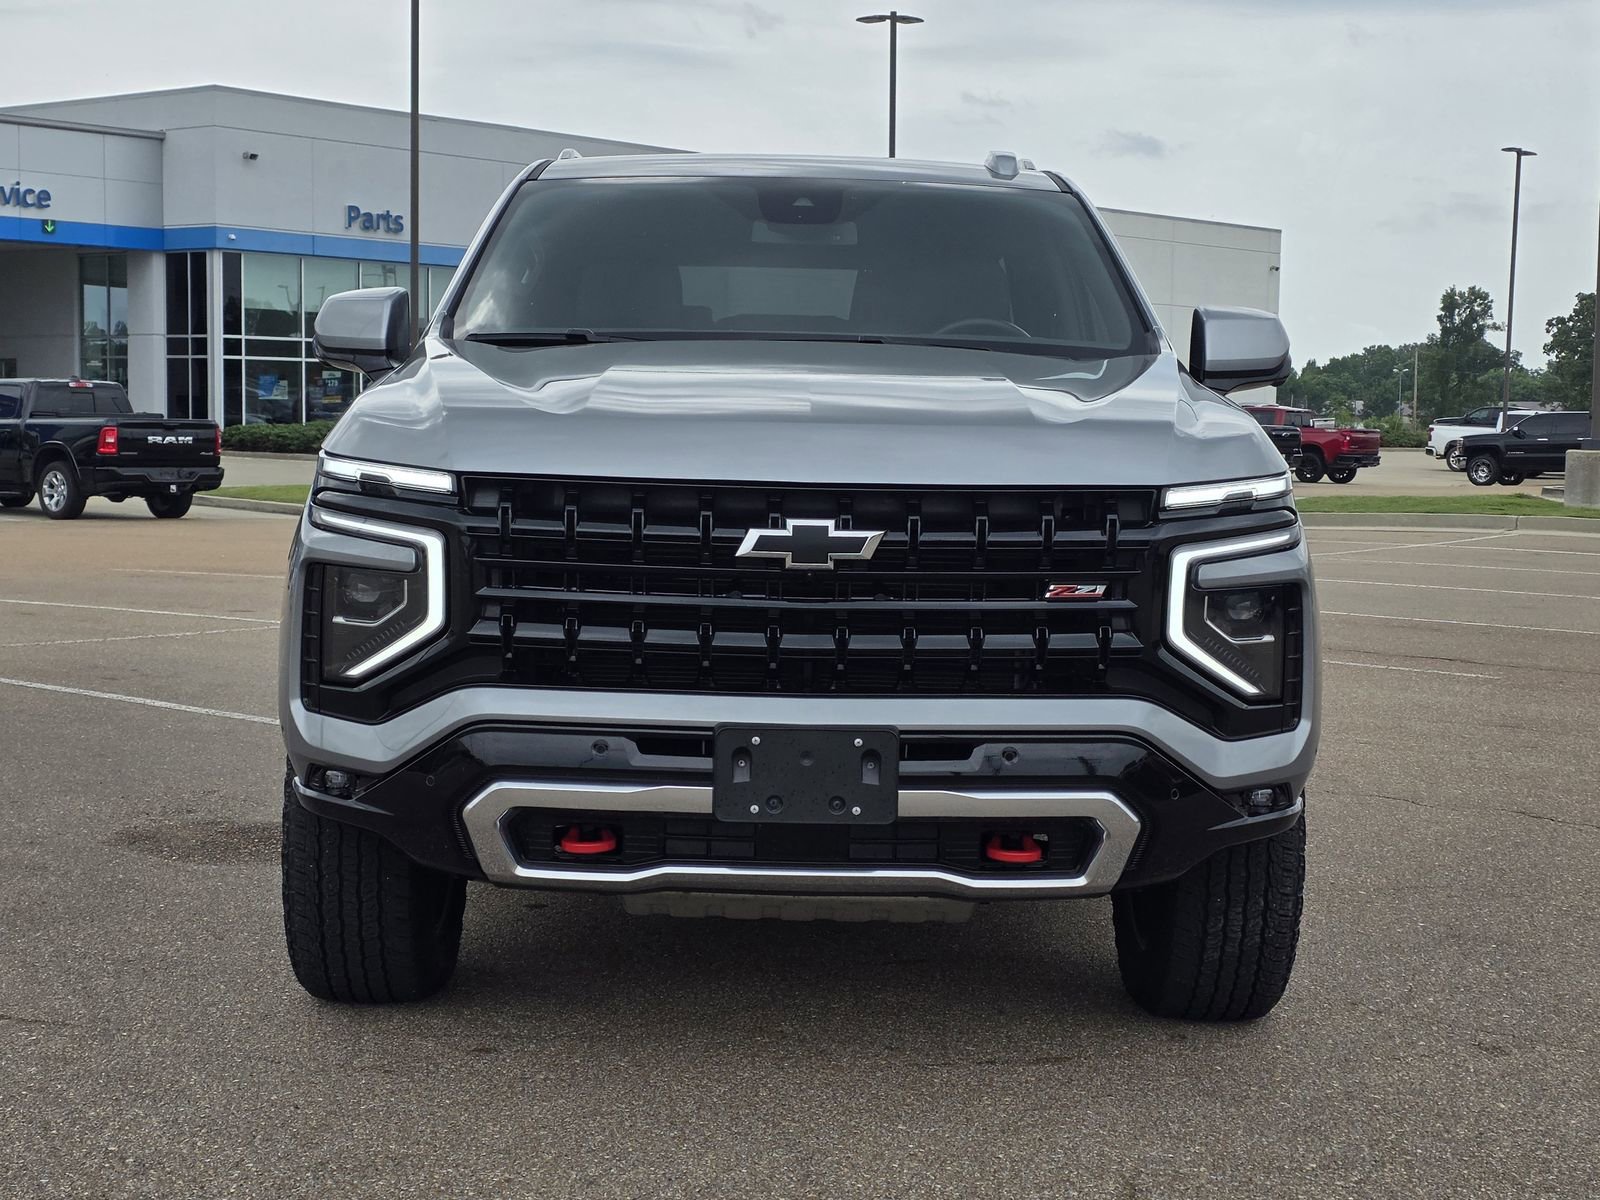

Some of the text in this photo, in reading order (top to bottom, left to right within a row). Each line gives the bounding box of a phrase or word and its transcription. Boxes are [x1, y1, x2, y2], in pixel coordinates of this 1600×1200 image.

[345, 204, 404, 233] Parts
[147, 436, 193, 444] RAM
[1045, 585, 1107, 597] Z71
